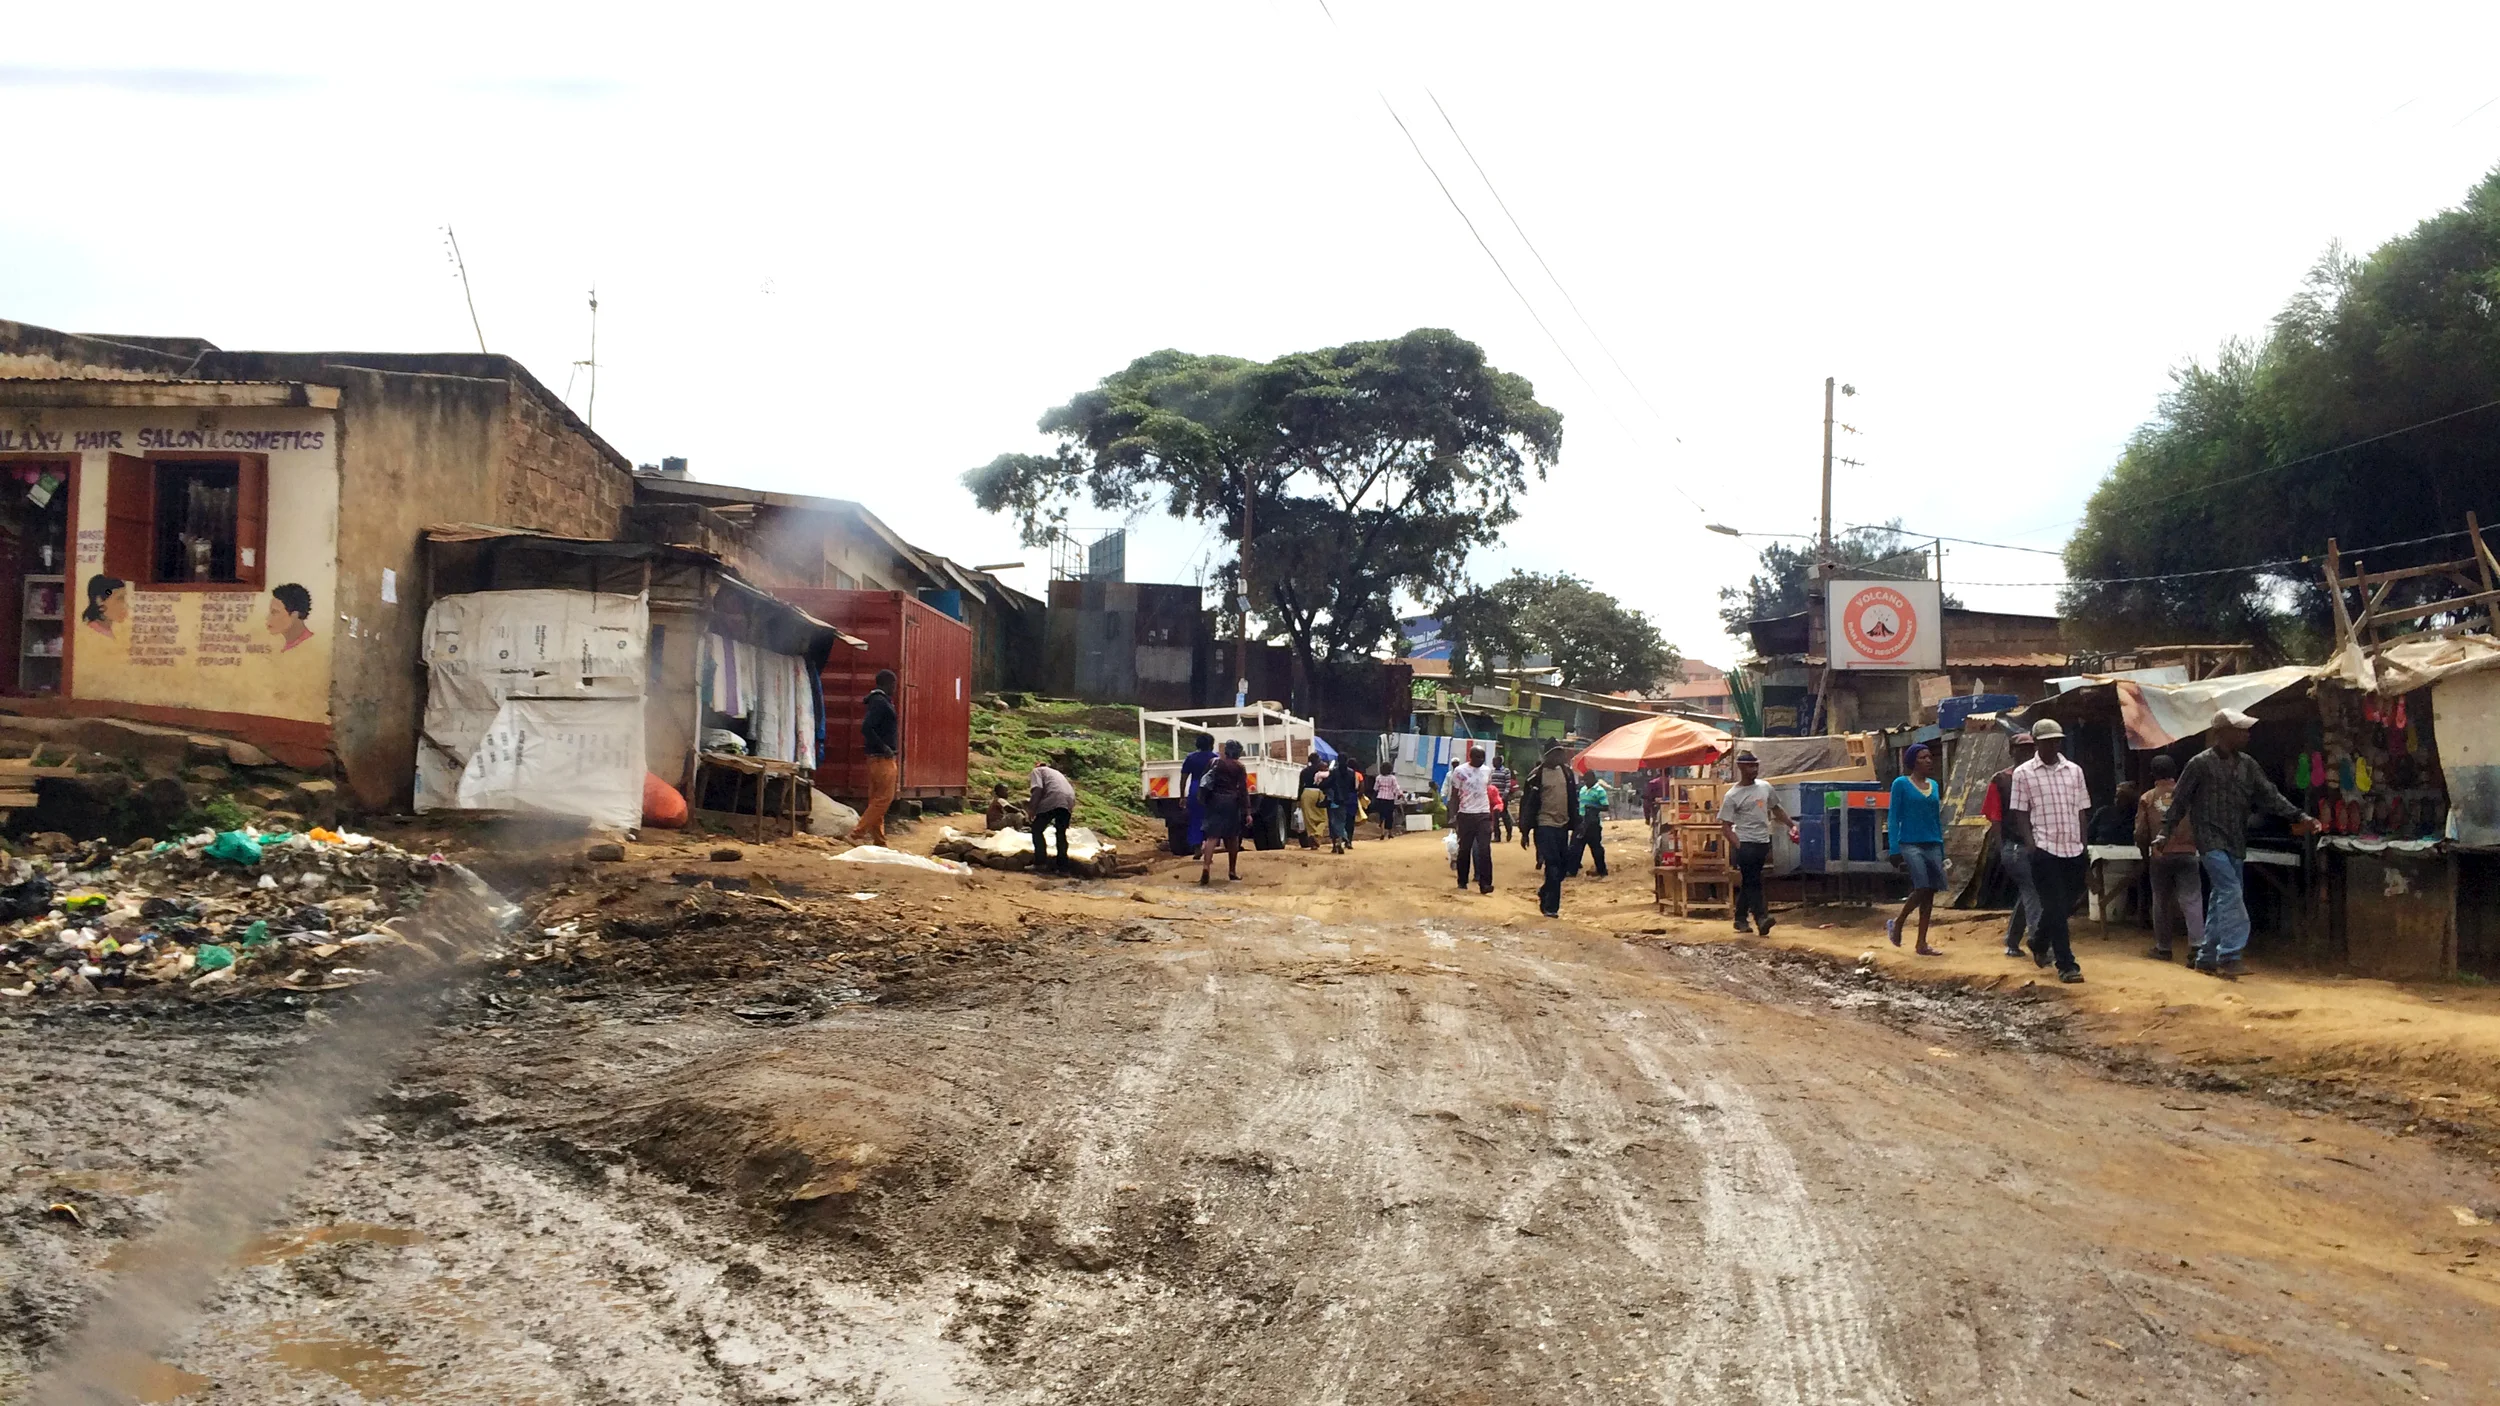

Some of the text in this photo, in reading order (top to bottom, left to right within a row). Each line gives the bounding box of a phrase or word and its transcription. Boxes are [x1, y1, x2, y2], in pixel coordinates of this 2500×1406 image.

[74, 430, 123, 449] HAIR
[137, 428, 204, 448] SALON
[222, 430, 325, 450] COSMETICS
[1855, 591, 1903, 609] VOLCANO
[1855, 640, 1873, 654] AND
